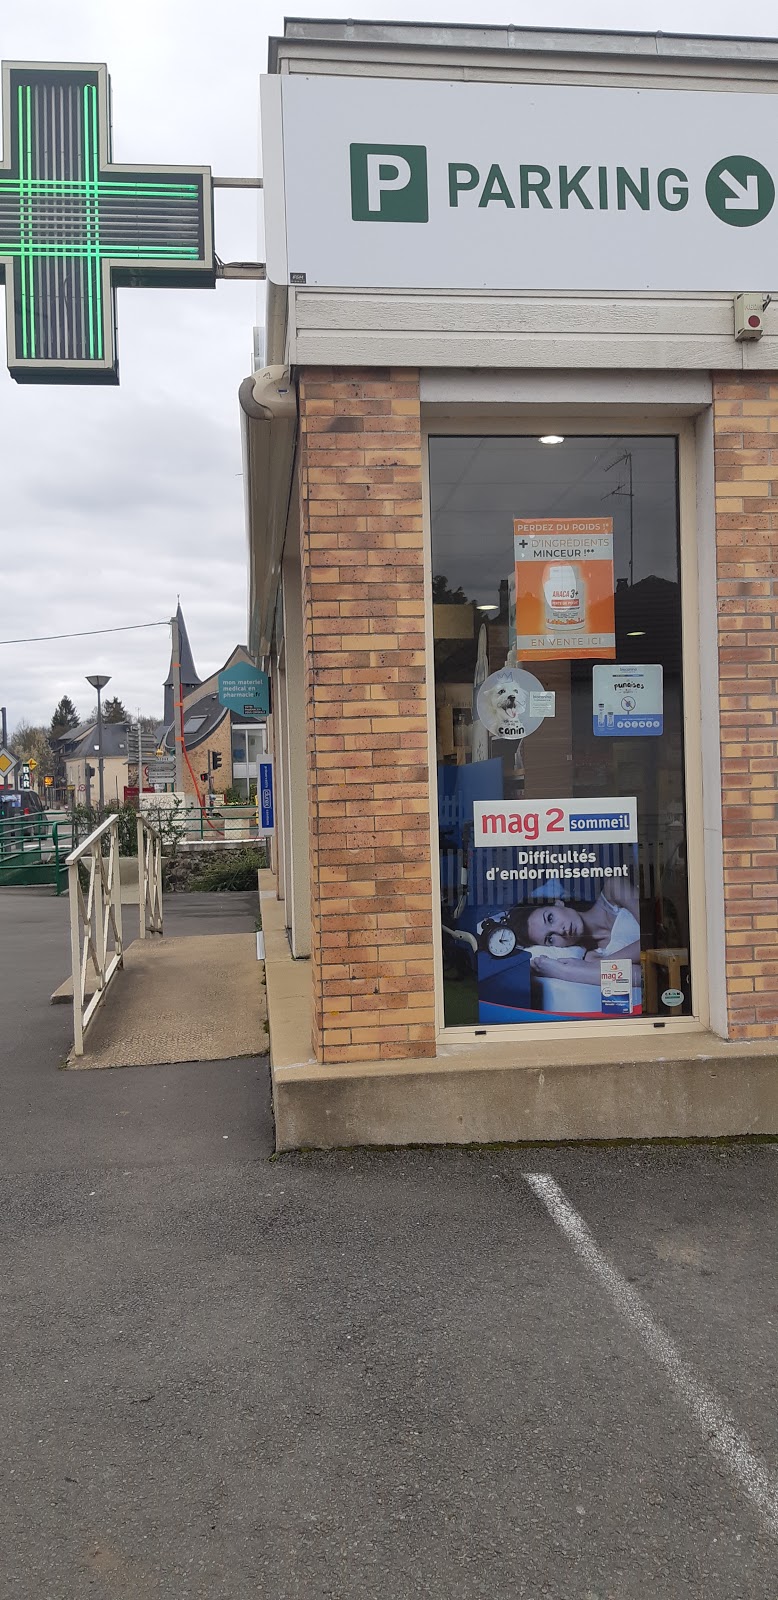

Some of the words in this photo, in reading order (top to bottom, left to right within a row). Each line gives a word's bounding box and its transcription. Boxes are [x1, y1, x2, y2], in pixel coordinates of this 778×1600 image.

[367, 153, 412, 212] P
[448, 162, 690, 211] PARKING
[572, 523, 601, 531] POIDS
[531, 538, 610, 548] D'INGRÉDIENTS
[533, 549, 581, 558] MINCEUR
[531, 639, 545, 647] EN
[548, 638, 583, 646] VENTE
[588, 637, 602, 645] ICI
[614, 682, 644, 691] punaises
[498, 726, 525, 735] canin
[482, 813, 540, 840] mag
[545, 808, 565, 832] 2
[570, 815, 629, 830] sommeil
[518, 849, 597, 865] Difficultés
[486, 864, 629, 881] d'endormissement
[601, 972, 617, 981] mag
[617, 971, 623, 979] 2
